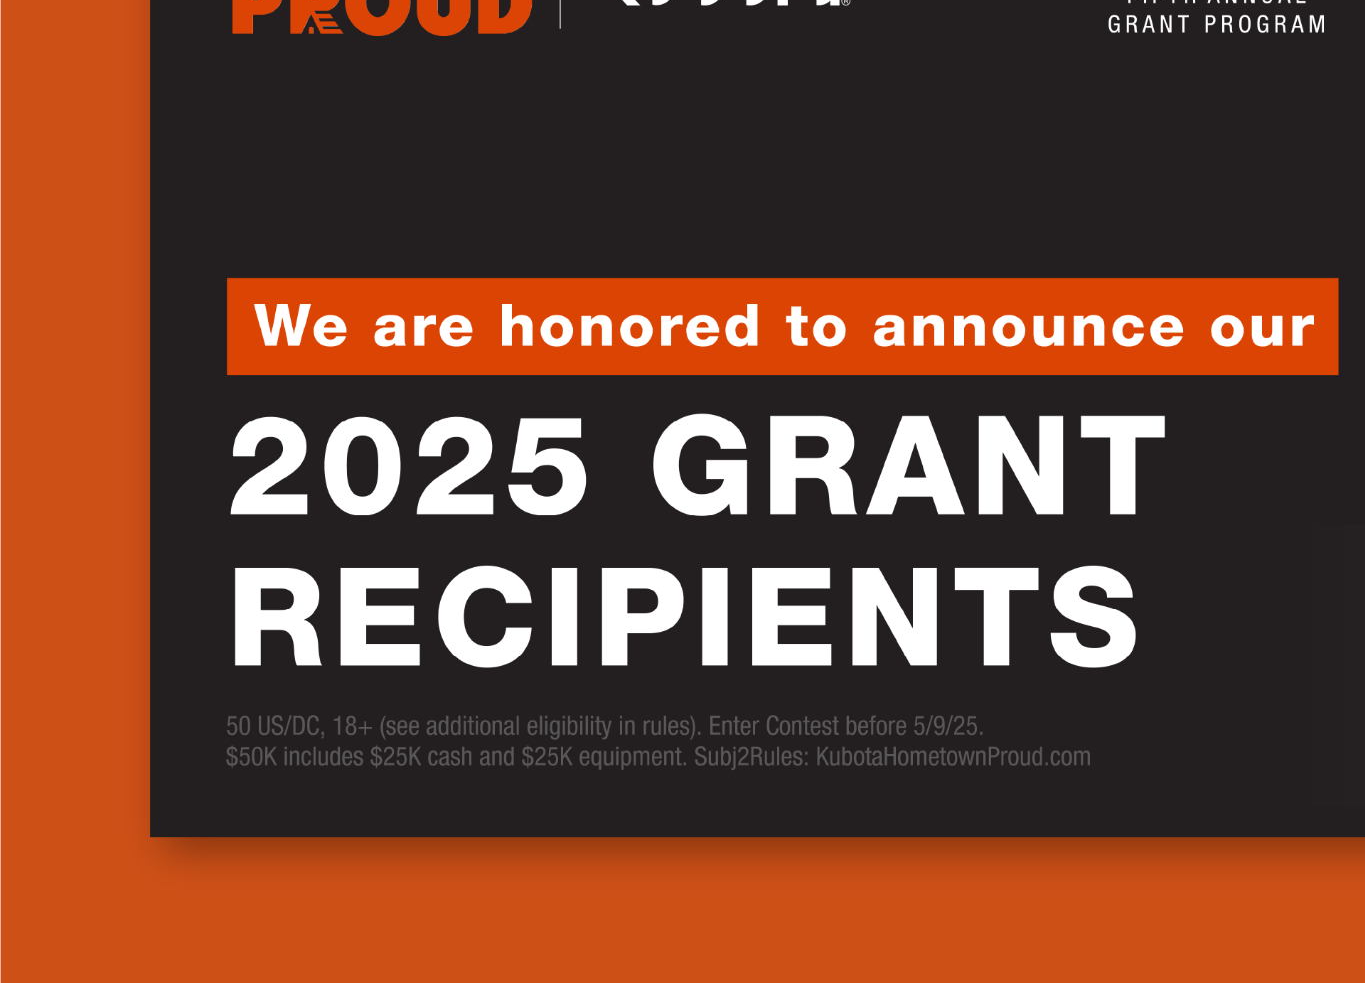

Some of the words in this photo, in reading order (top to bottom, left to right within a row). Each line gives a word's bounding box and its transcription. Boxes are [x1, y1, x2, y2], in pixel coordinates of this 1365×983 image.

[1107, 14, 1190, 34] GRANT
[1205, 14, 1325, 34] PROGRAM
[253, 303, 347, 348] We
[374, 314, 473, 348] are
[501, 303, 758, 348] honored
[785, 305, 847, 348] to
[873, 314, 1184, 348] announce
[1210, 314, 1315, 348] our
[230, 416, 587, 516] 2025
[652, 413, 1166, 517] GRANT
[234, 565, 1137, 669] RECIPIENTS
[226, 715, 251, 736] 50
[258, 714, 325, 739] US/DC,
[333, 715, 373, 736] 18+
[379, 715, 420, 741] (see
[426, 715, 520, 736] additional
[526, 715, 613, 741] eligibility
[619, 715, 636, 736] in
[643, 715, 702, 741] rules).
[709, 715, 760, 736] Enter
[766, 714, 840, 736] Contest
[846, 714, 907, 736] before
[913, 714, 984, 736] 5/9/25.
[225, 745, 278, 769] $50K
[283, 746, 364, 767] includes
[370, 744, 422, 769] $25K
[427, 746, 472, 767] cash
[479, 746, 515, 767] and
[521, 745, 573, 769] $25K
[579, 746, 687, 771] equipment.
[694, 745, 809, 771] Subj2Rules:
[816, 746, 1091, 767] KubotaHometownProud.com
